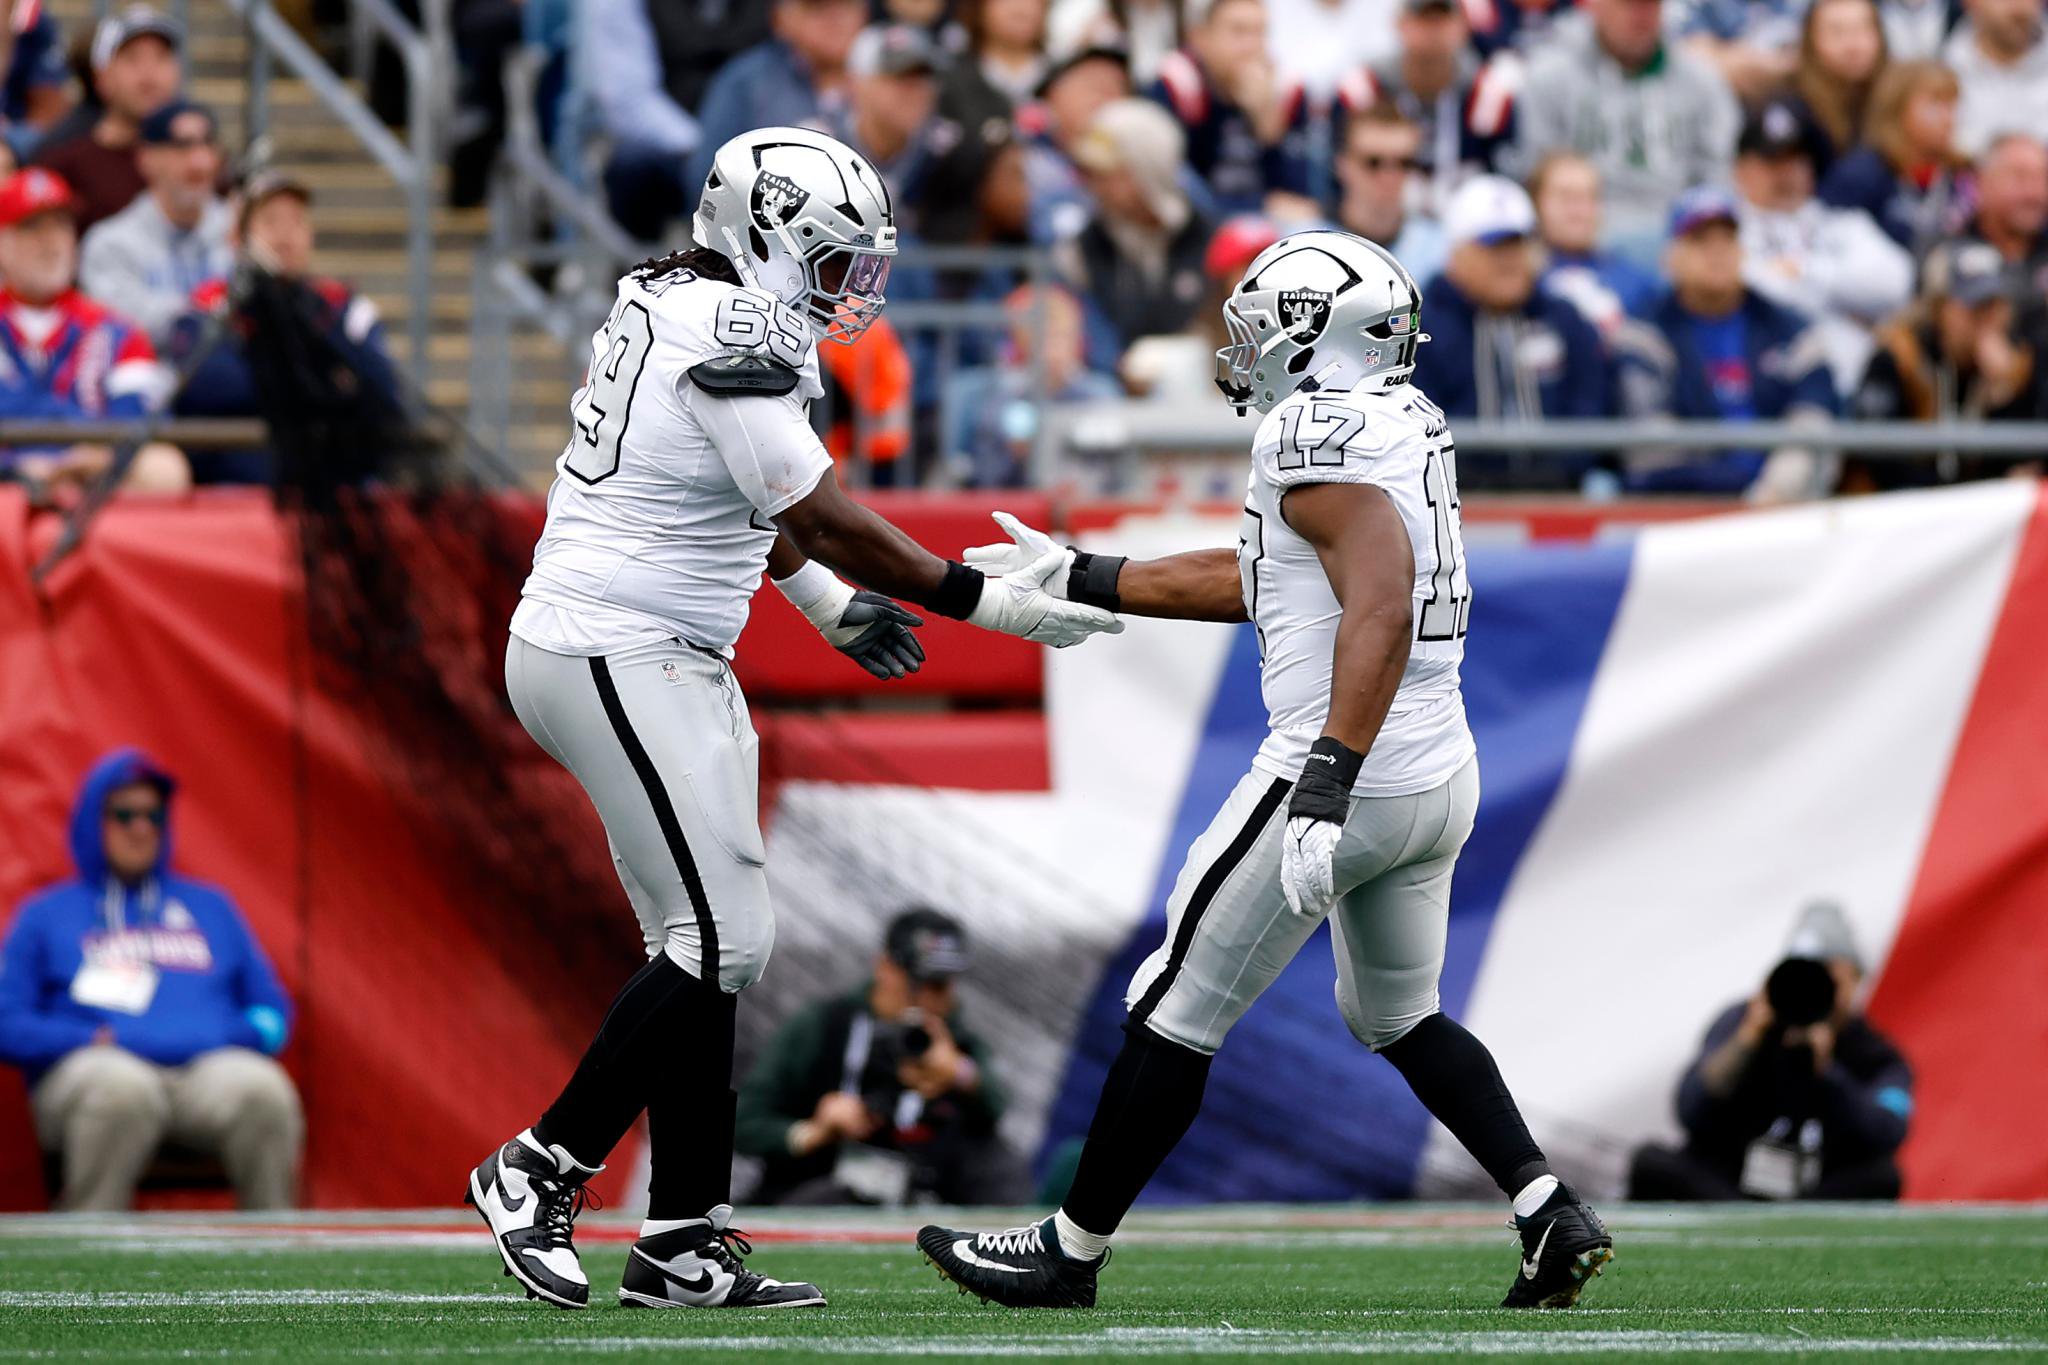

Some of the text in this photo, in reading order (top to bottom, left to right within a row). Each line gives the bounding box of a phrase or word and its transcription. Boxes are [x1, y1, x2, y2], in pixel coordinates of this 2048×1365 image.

[763, 172, 806, 198] RAIDERS
[1282, 290, 1328, 302] RAIDERS
[714, 287, 812, 369] 69
[1276, 403, 1366, 471] 17
